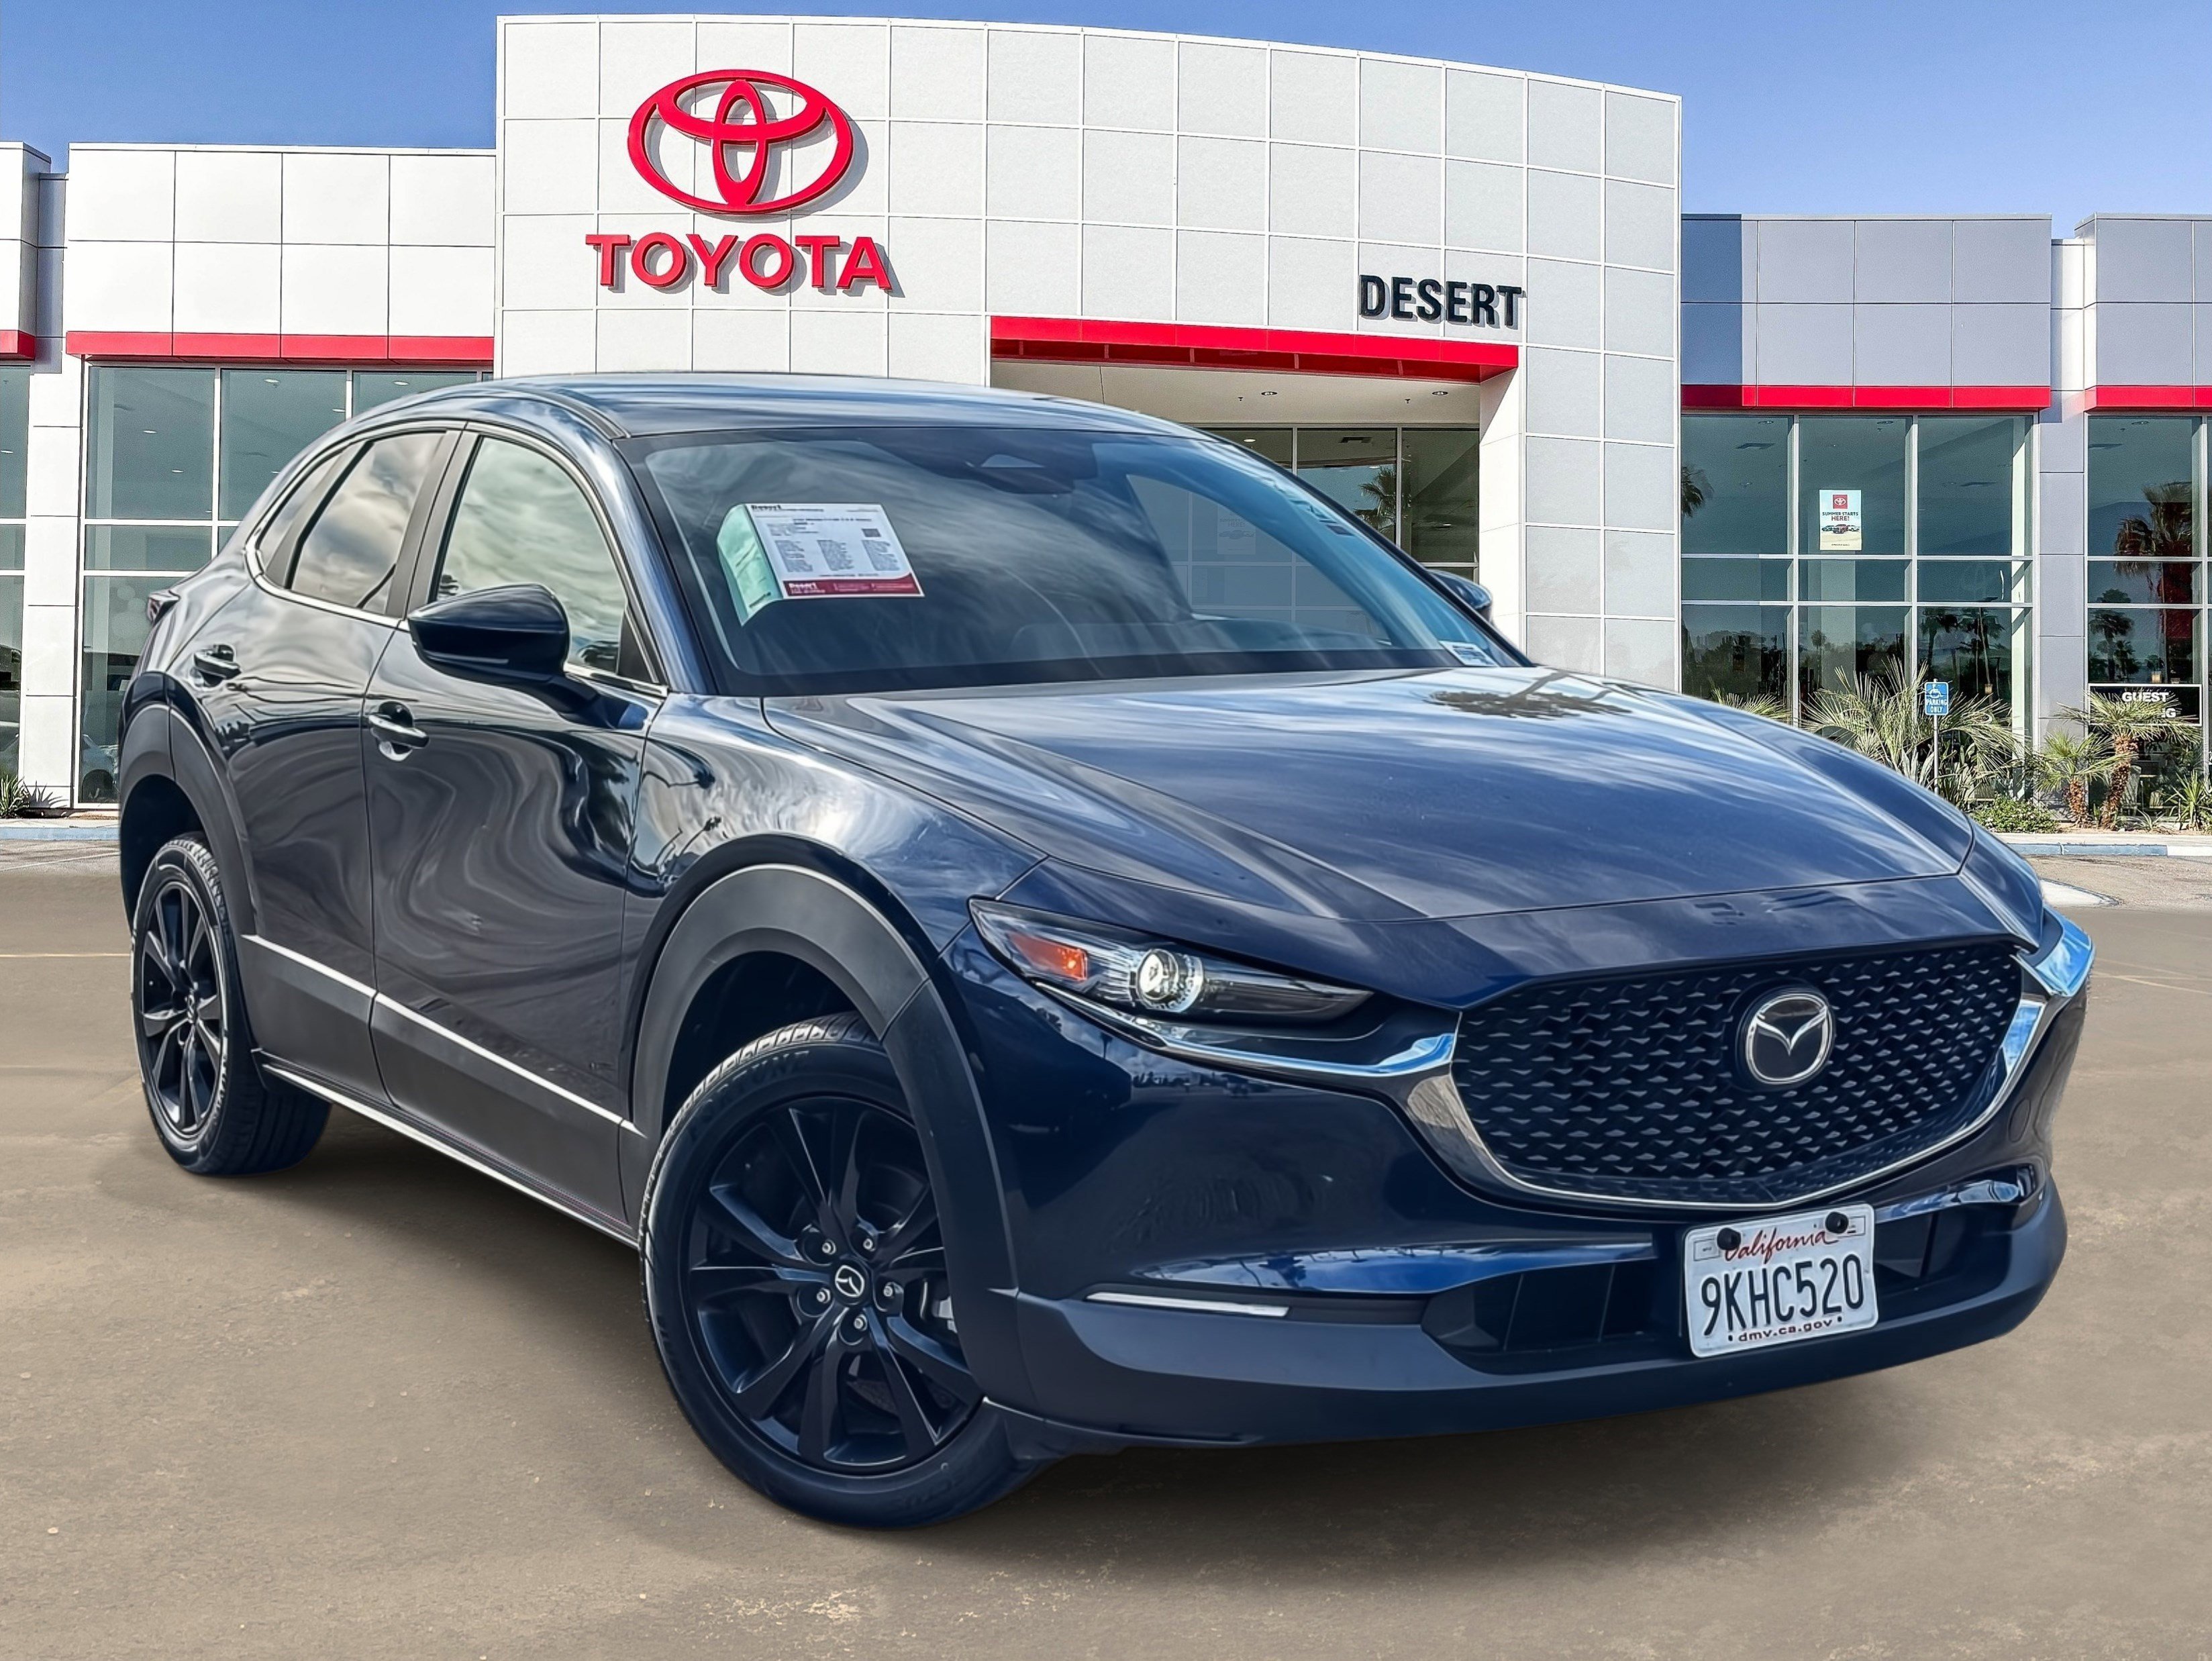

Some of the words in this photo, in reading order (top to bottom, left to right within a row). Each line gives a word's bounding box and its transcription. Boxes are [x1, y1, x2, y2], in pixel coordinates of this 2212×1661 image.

[585, 232, 892, 291] TOYOTA
[1358, 274, 1522, 327] DESERT
[2121, 692, 2169, 703] GUEST
[1701, 1254, 1864, 1336] 9KHC520
[1738, 1318, 1833, 1342] dmv.ca.gov
